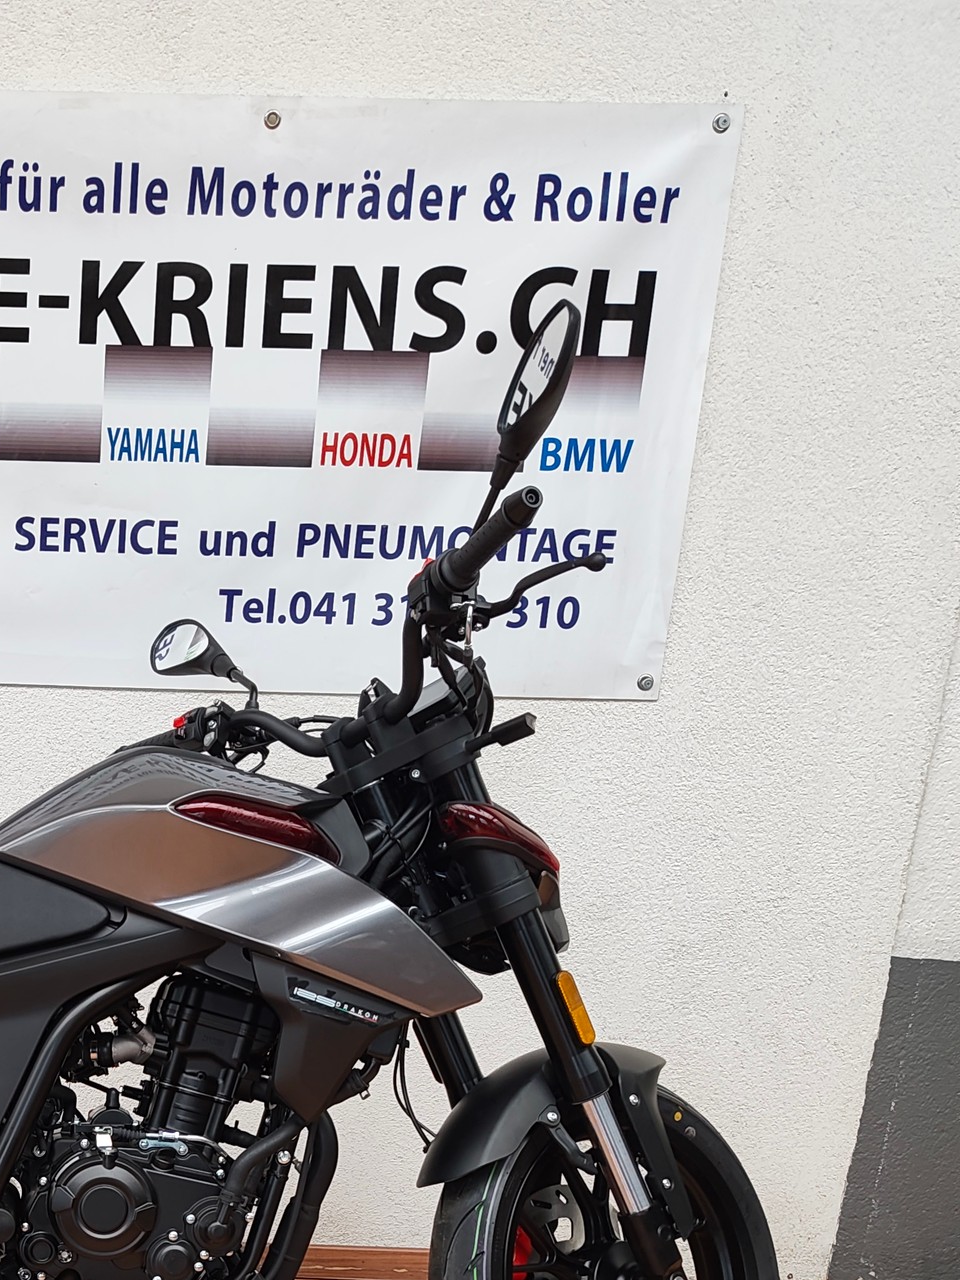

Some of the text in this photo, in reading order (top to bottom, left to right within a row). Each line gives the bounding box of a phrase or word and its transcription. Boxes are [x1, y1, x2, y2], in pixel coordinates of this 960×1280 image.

[83, 162, 168, 215] alle
[187, 166, 467, 222] Motorräder
[483, 172, 516, 222] &
[534, 171, 681, 224] Roller
[107, 427, 200, 463] YAMAHA
[320, 432, 413, 468] HONDA
[539, 437, 635, 473] BMW
[15, 516, 178, 556] SERVICE
[199, 521, 276, 558] und
[219, 588, 356, 626] Tel.041
[505, 596, 581, 631] 310
[335, 1001, 379, 1021] DRAKON
